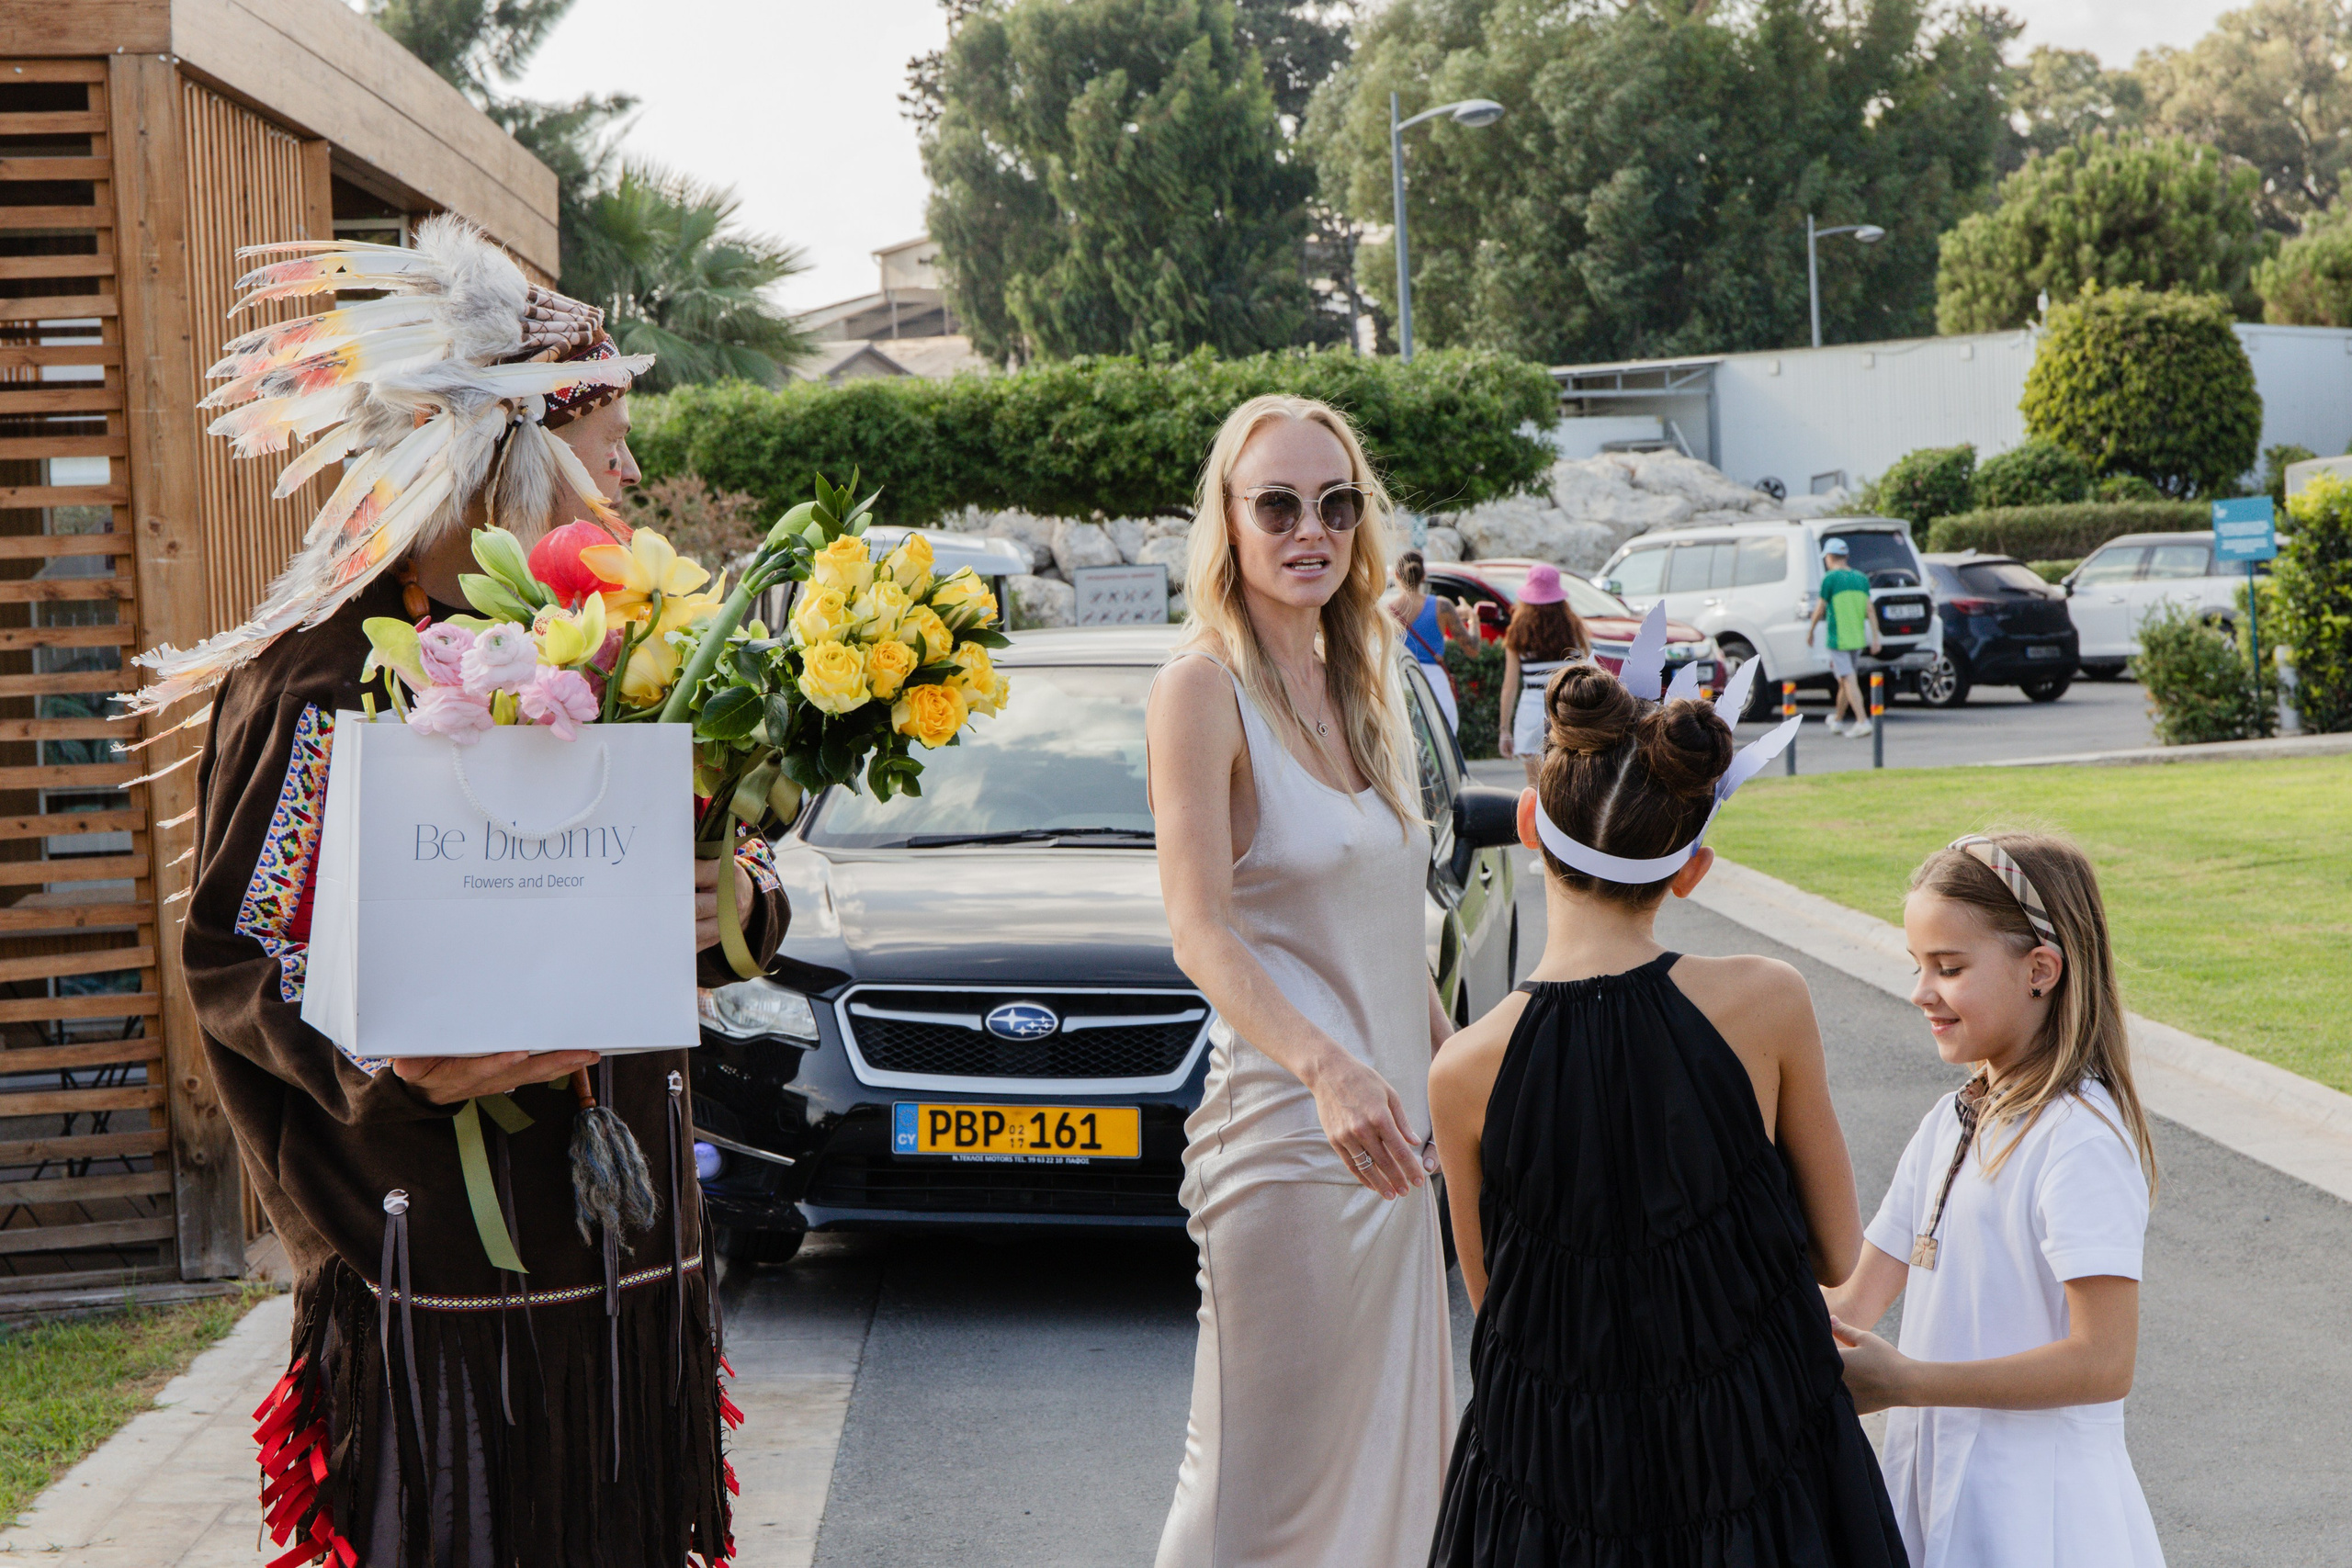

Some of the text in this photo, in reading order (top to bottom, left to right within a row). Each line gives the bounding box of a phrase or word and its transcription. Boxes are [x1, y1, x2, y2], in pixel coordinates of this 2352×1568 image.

[414, 825, 465, 861] Be
[463, 874, 585, 889] Flowers and Decor
[898, 1134, 916, 1145] CY
[929, 1110, 1102, 1150] PBP 161
